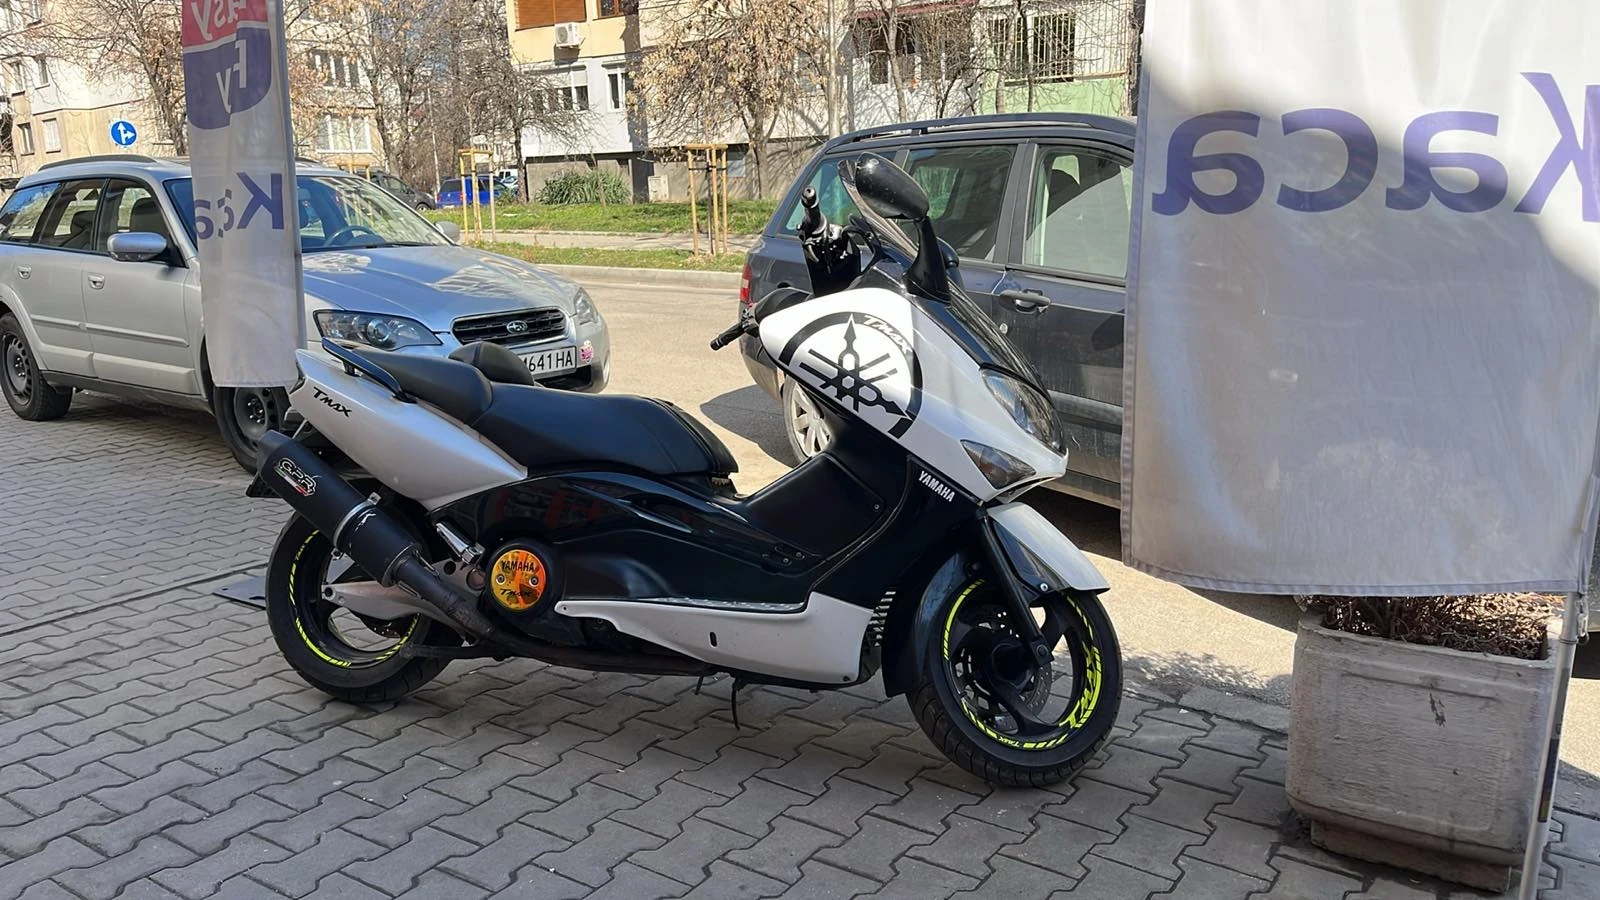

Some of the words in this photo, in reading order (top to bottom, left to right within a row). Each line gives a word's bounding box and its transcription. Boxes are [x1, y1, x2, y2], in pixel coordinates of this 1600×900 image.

[524, 354, 552, 372] 641
[556, 350, 573, 368] HA
[313, 386, 352, 417] TMAX
[918, 470, 956, 502] YAMAHA
[501, 560, 535, 572] YAMAHA
